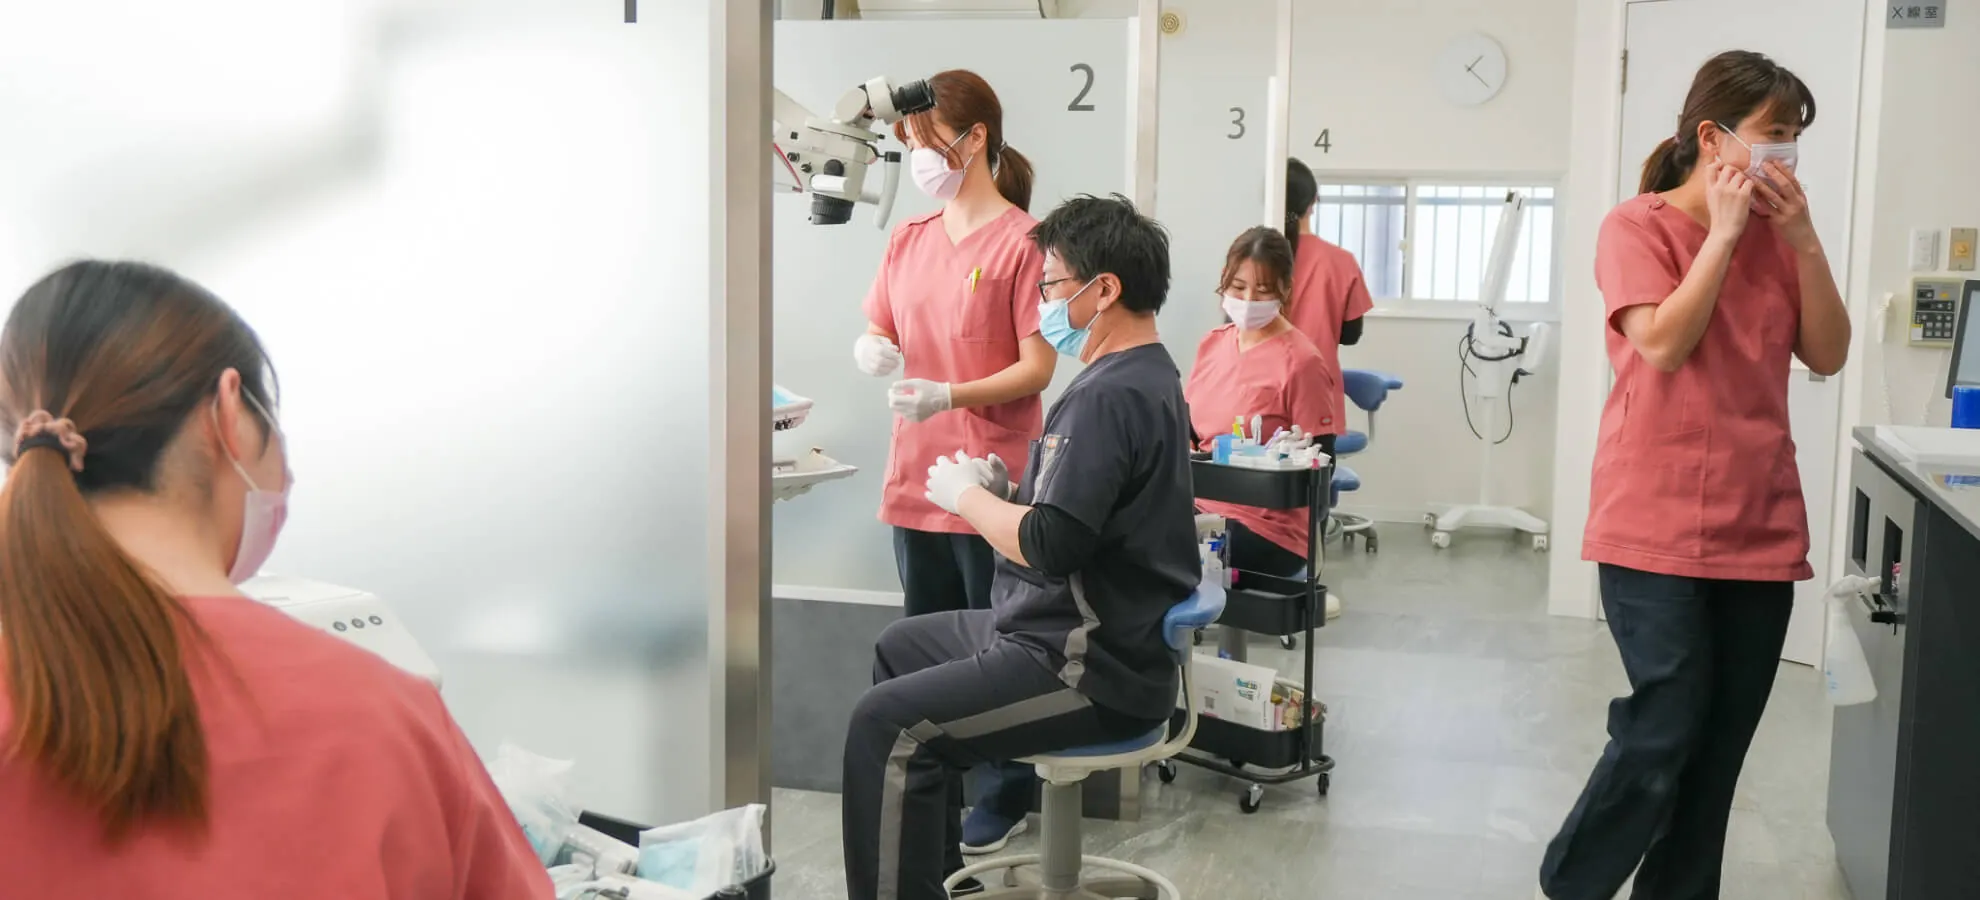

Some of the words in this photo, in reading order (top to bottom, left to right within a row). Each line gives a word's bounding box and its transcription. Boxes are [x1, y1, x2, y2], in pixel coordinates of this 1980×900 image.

[1067, 63, 1095, 112] 2
[1227, 107, 1246, 140] 3
[1313, 128, 1332, 154] 4
